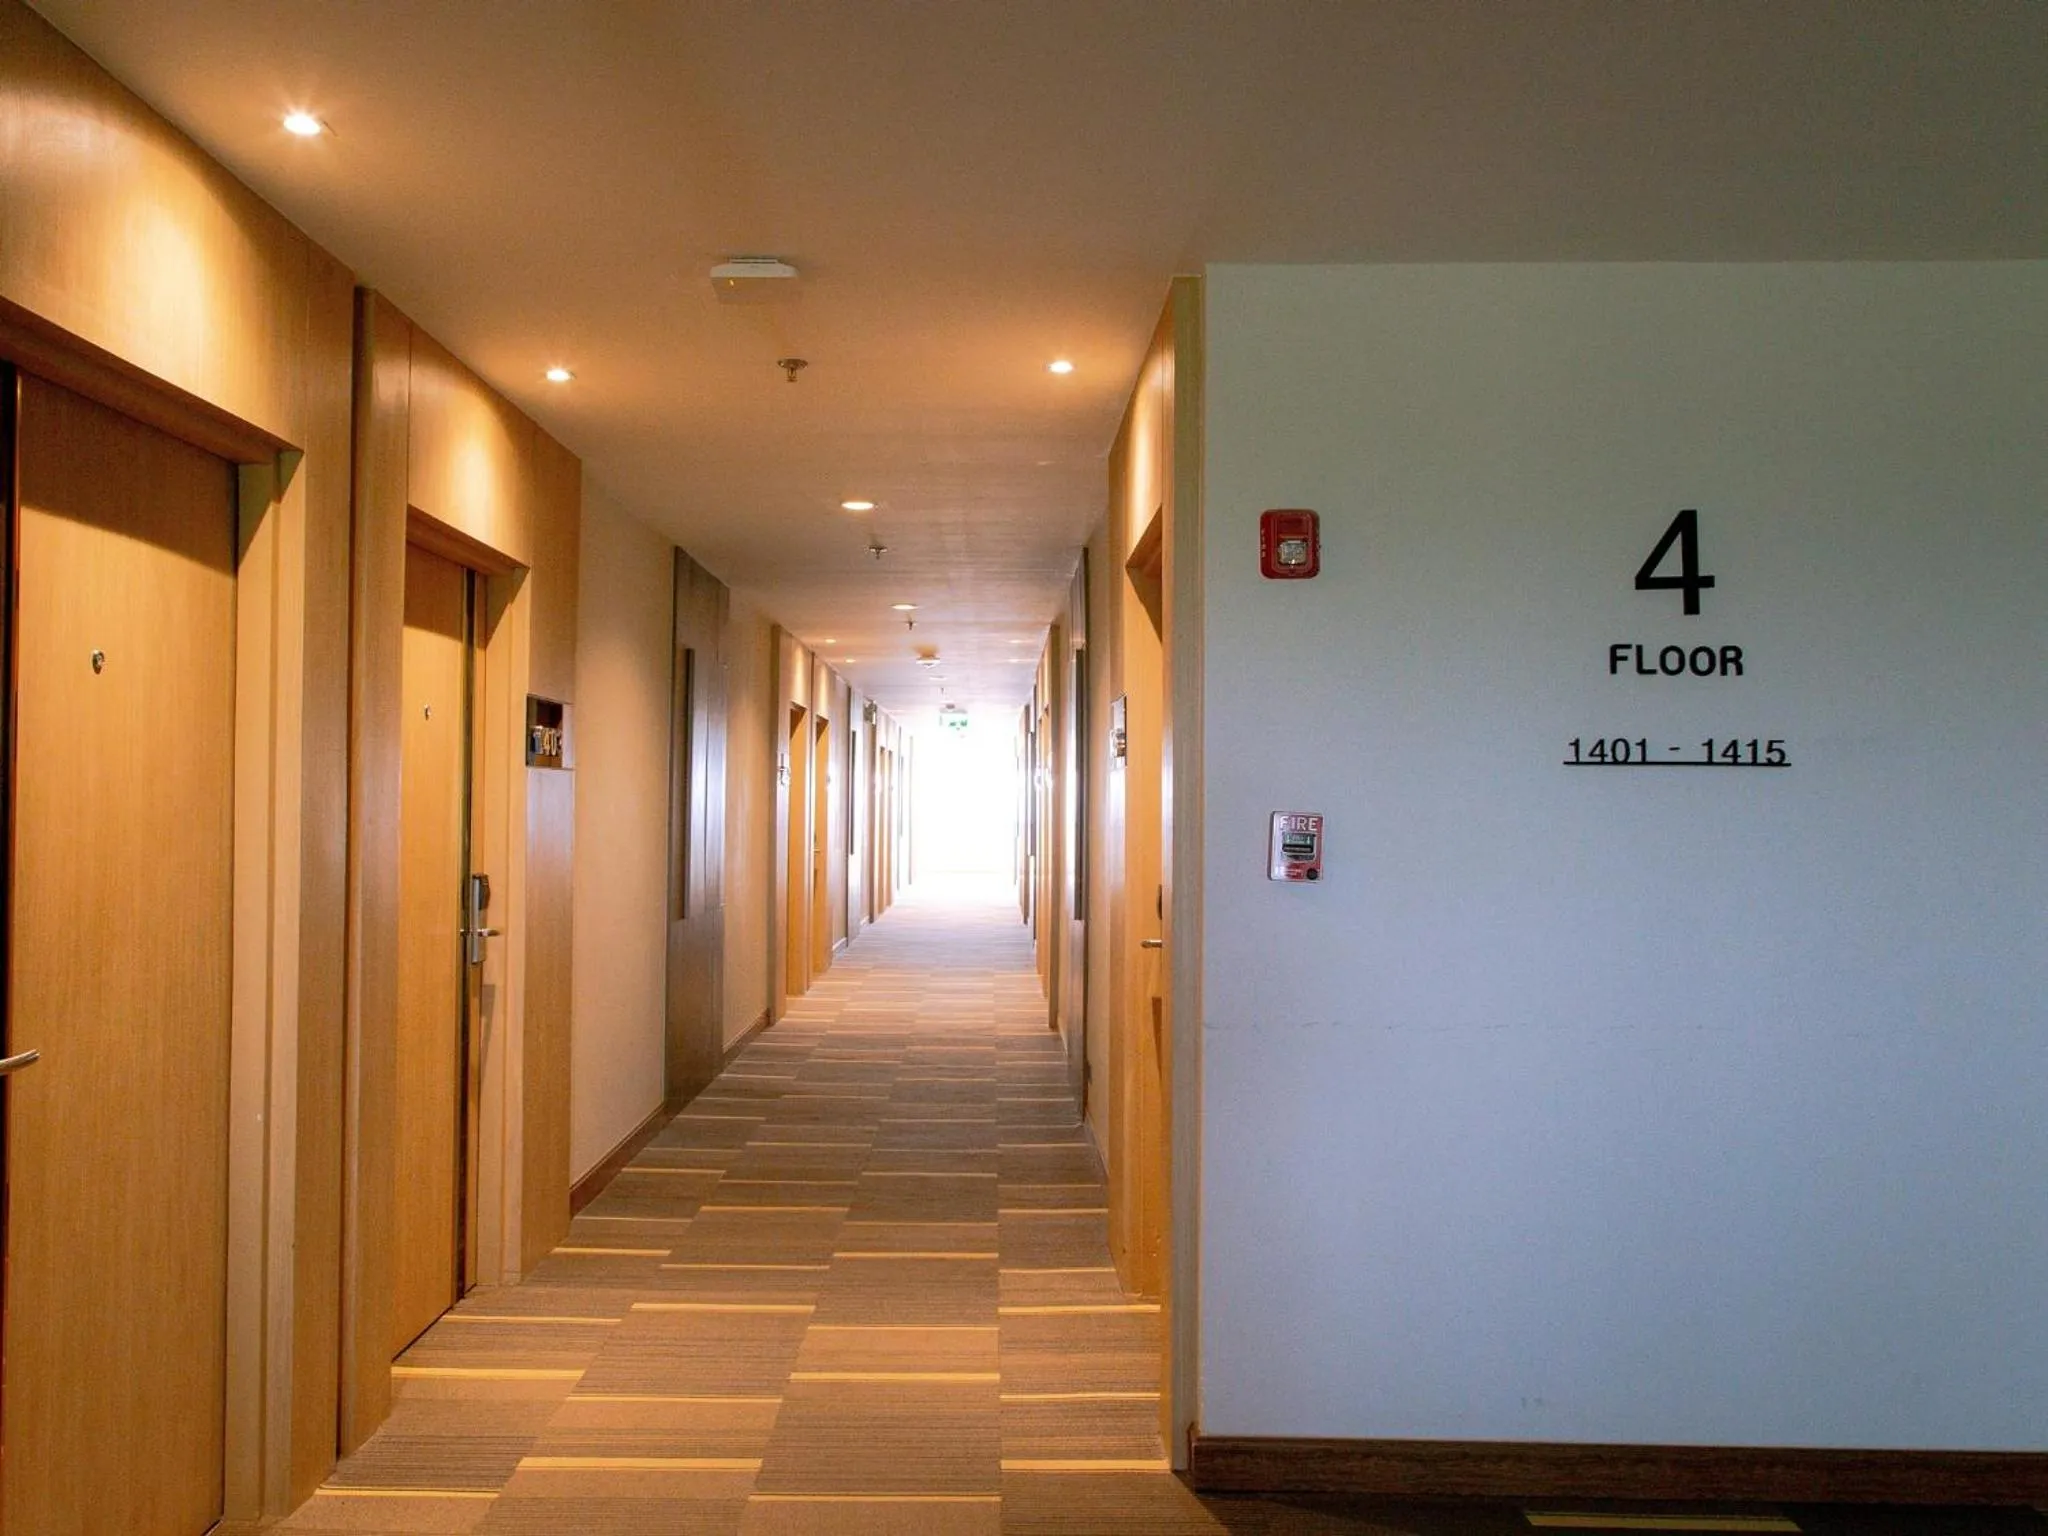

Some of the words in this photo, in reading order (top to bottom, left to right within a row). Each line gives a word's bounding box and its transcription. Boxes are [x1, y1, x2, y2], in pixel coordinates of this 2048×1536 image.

[1635, 509, 1715, 615] 4
[1609, 644, 1743, 676] FLOOR
[1568, 738, 1648, 764] 1401
[1701, 738, 1786, 766] 1415
[1280, 815, 1318, 831] FIRE
